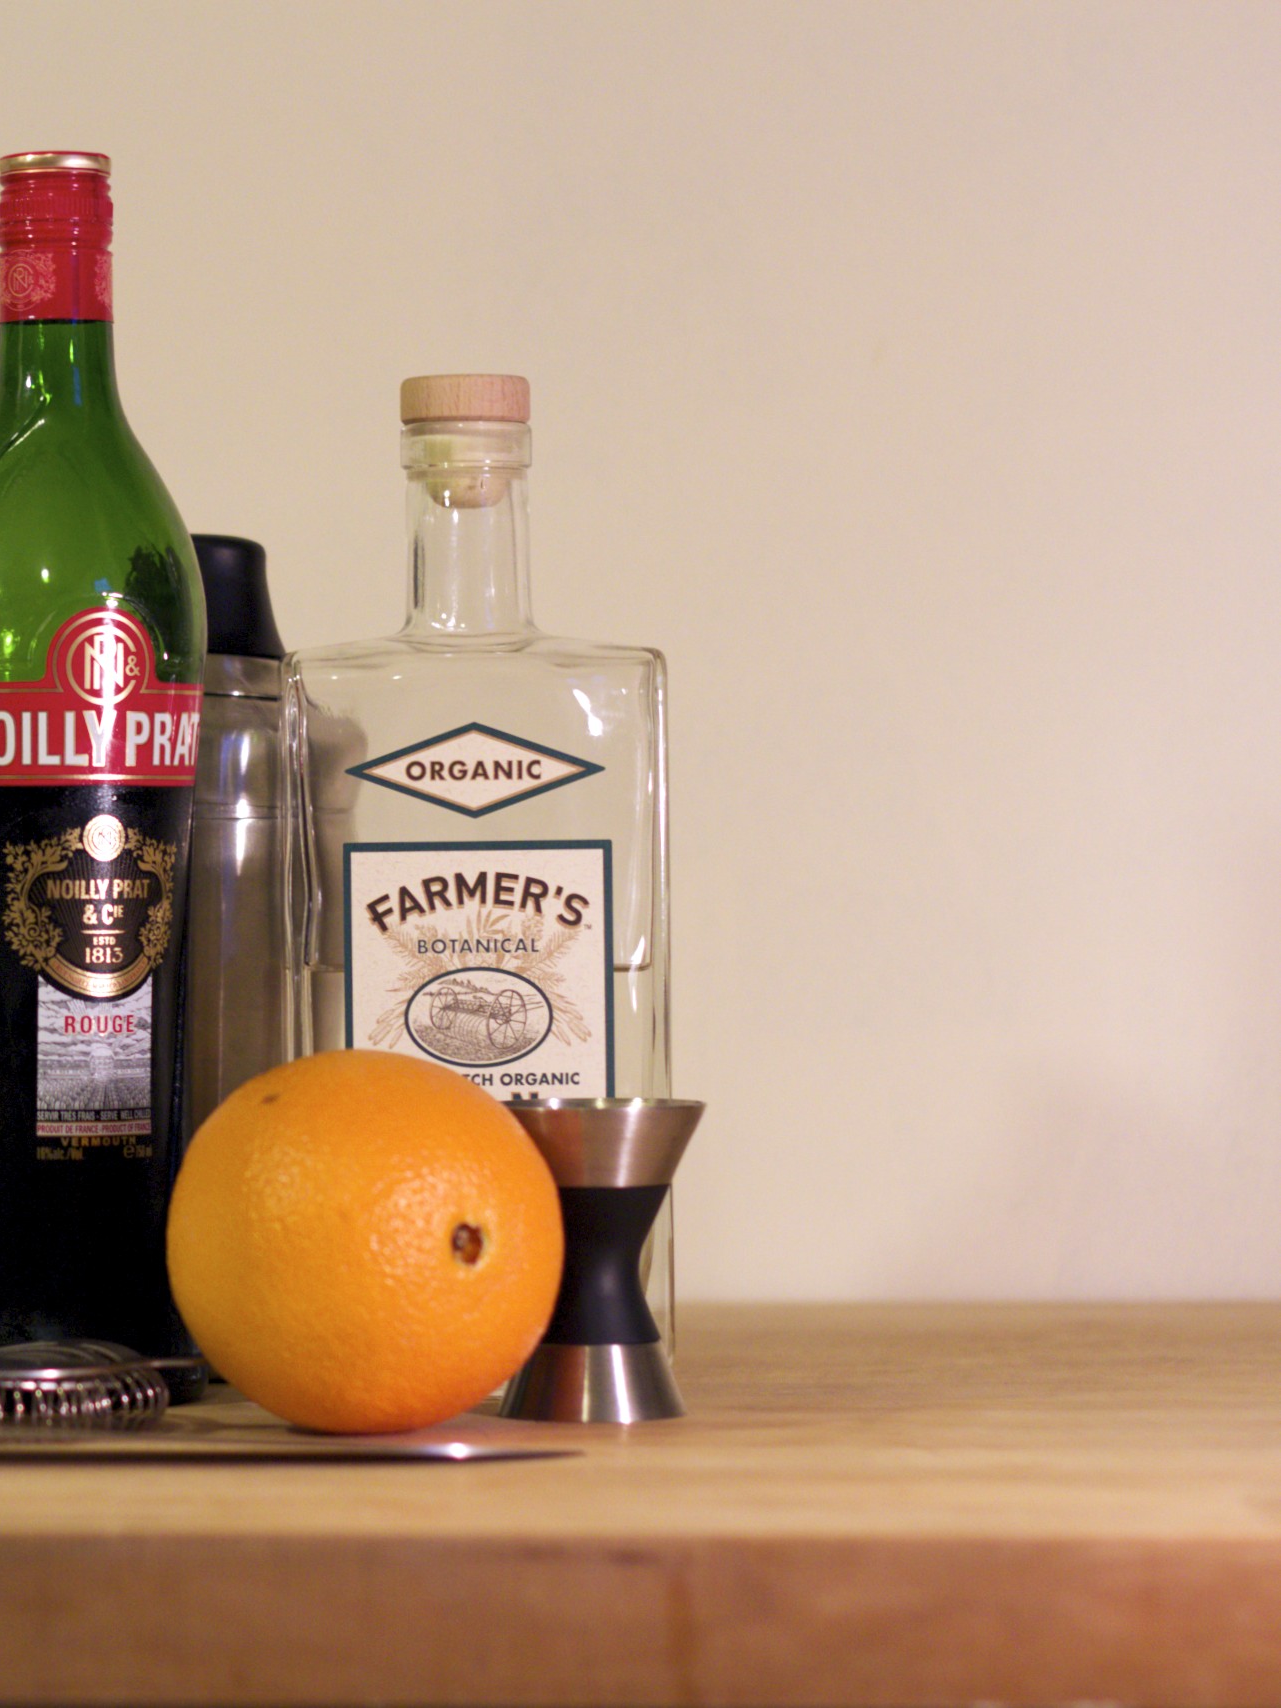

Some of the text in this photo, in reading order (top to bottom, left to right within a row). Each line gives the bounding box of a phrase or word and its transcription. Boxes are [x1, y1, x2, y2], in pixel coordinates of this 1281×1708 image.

[125, 711, 200, 767] PRAT
[405, 760, 542, 781] ORGANIC
[47, 879, 151, 900] NOILLY PRAT
[366, 871, 590, 932] FARMER'S
[82, 904, 98, 925] &
[418, 938, 540, 954] BOTANICAL
[85, 948, 123, 964] 1813
[64, 1014, 135, 1033] ROUGE
[500, 1072, 579, 1086] ORGANIC
[37, 1124, 63, 1133] PRODUIT
[65, 1124, 73, 1133] DE
[75, 1124, 98, 1133] FRANCE
[60, 1136, 136, 1147] VERMOUTH
